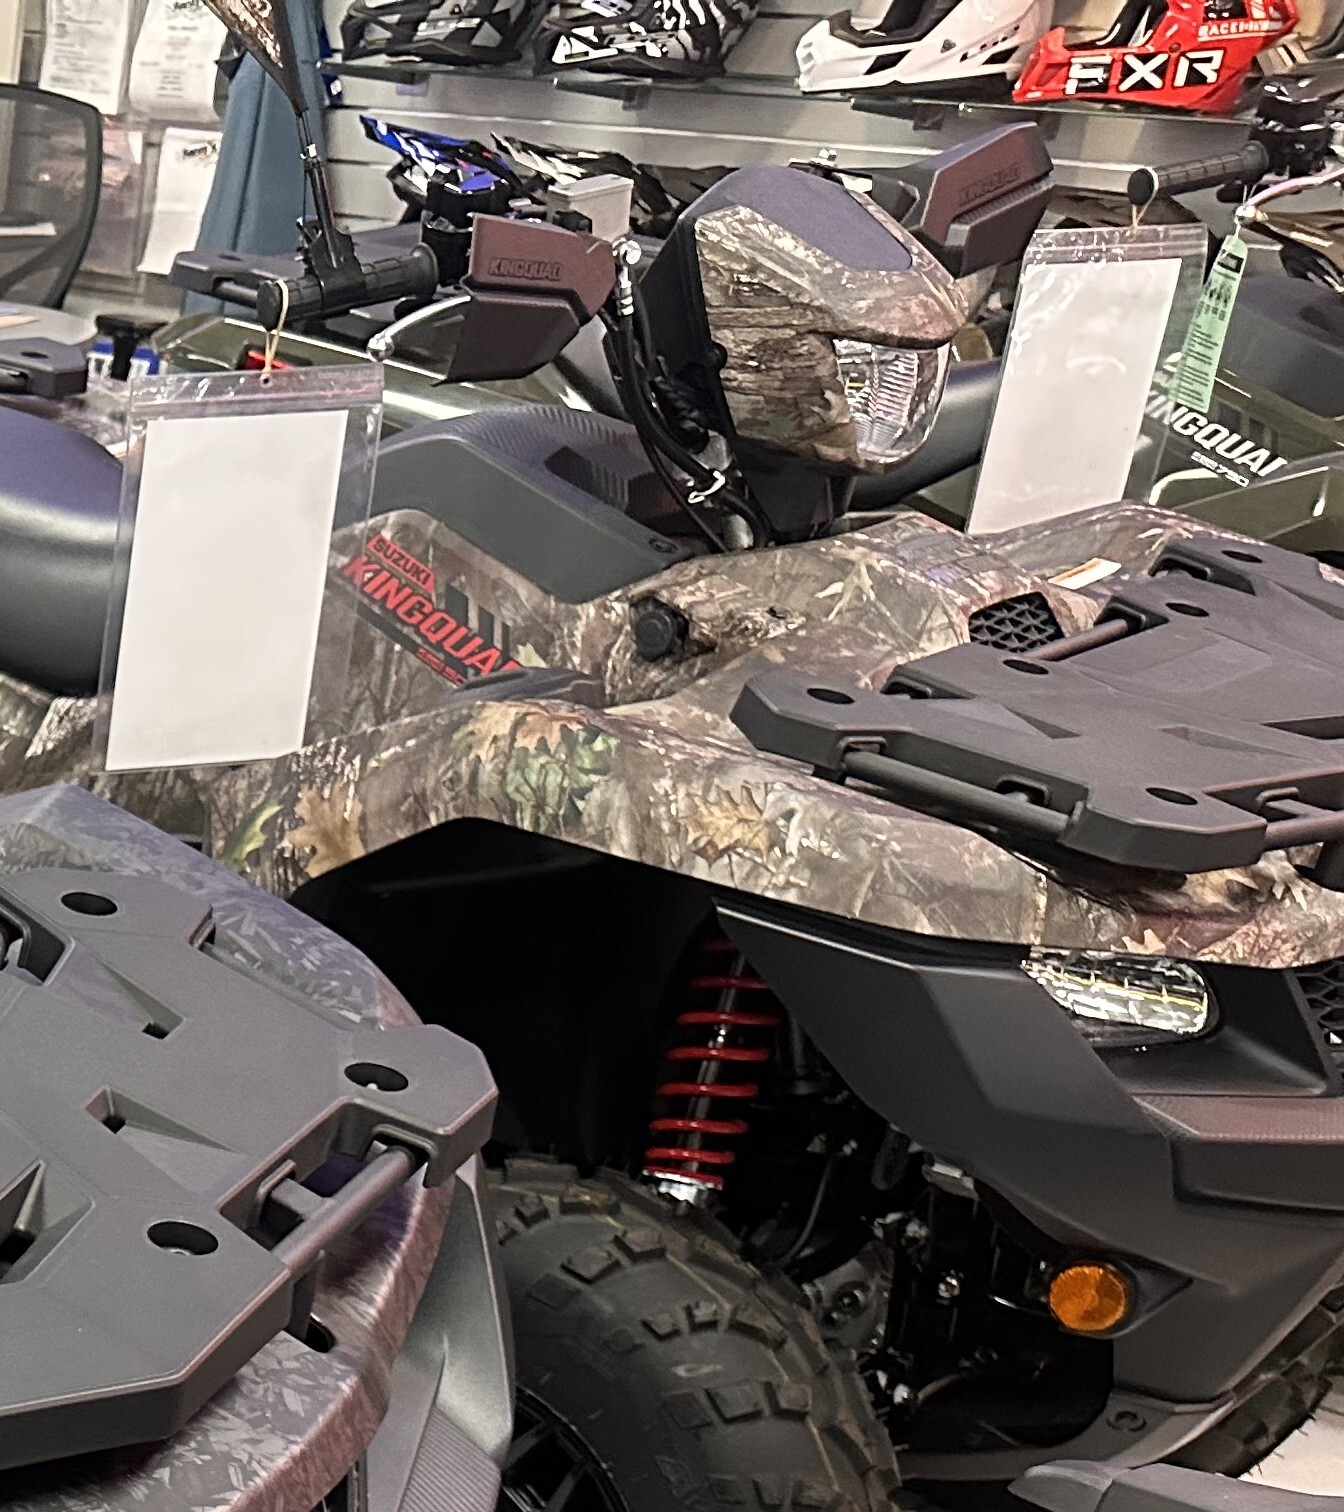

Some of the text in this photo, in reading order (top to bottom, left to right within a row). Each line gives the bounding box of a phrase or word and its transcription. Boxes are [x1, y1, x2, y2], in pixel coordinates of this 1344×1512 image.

[1064, 49, 1225, 95] FXR
[1146, 393, 1289, 477] INGQUA
[373, 537, 432, 585] SUZUKI
